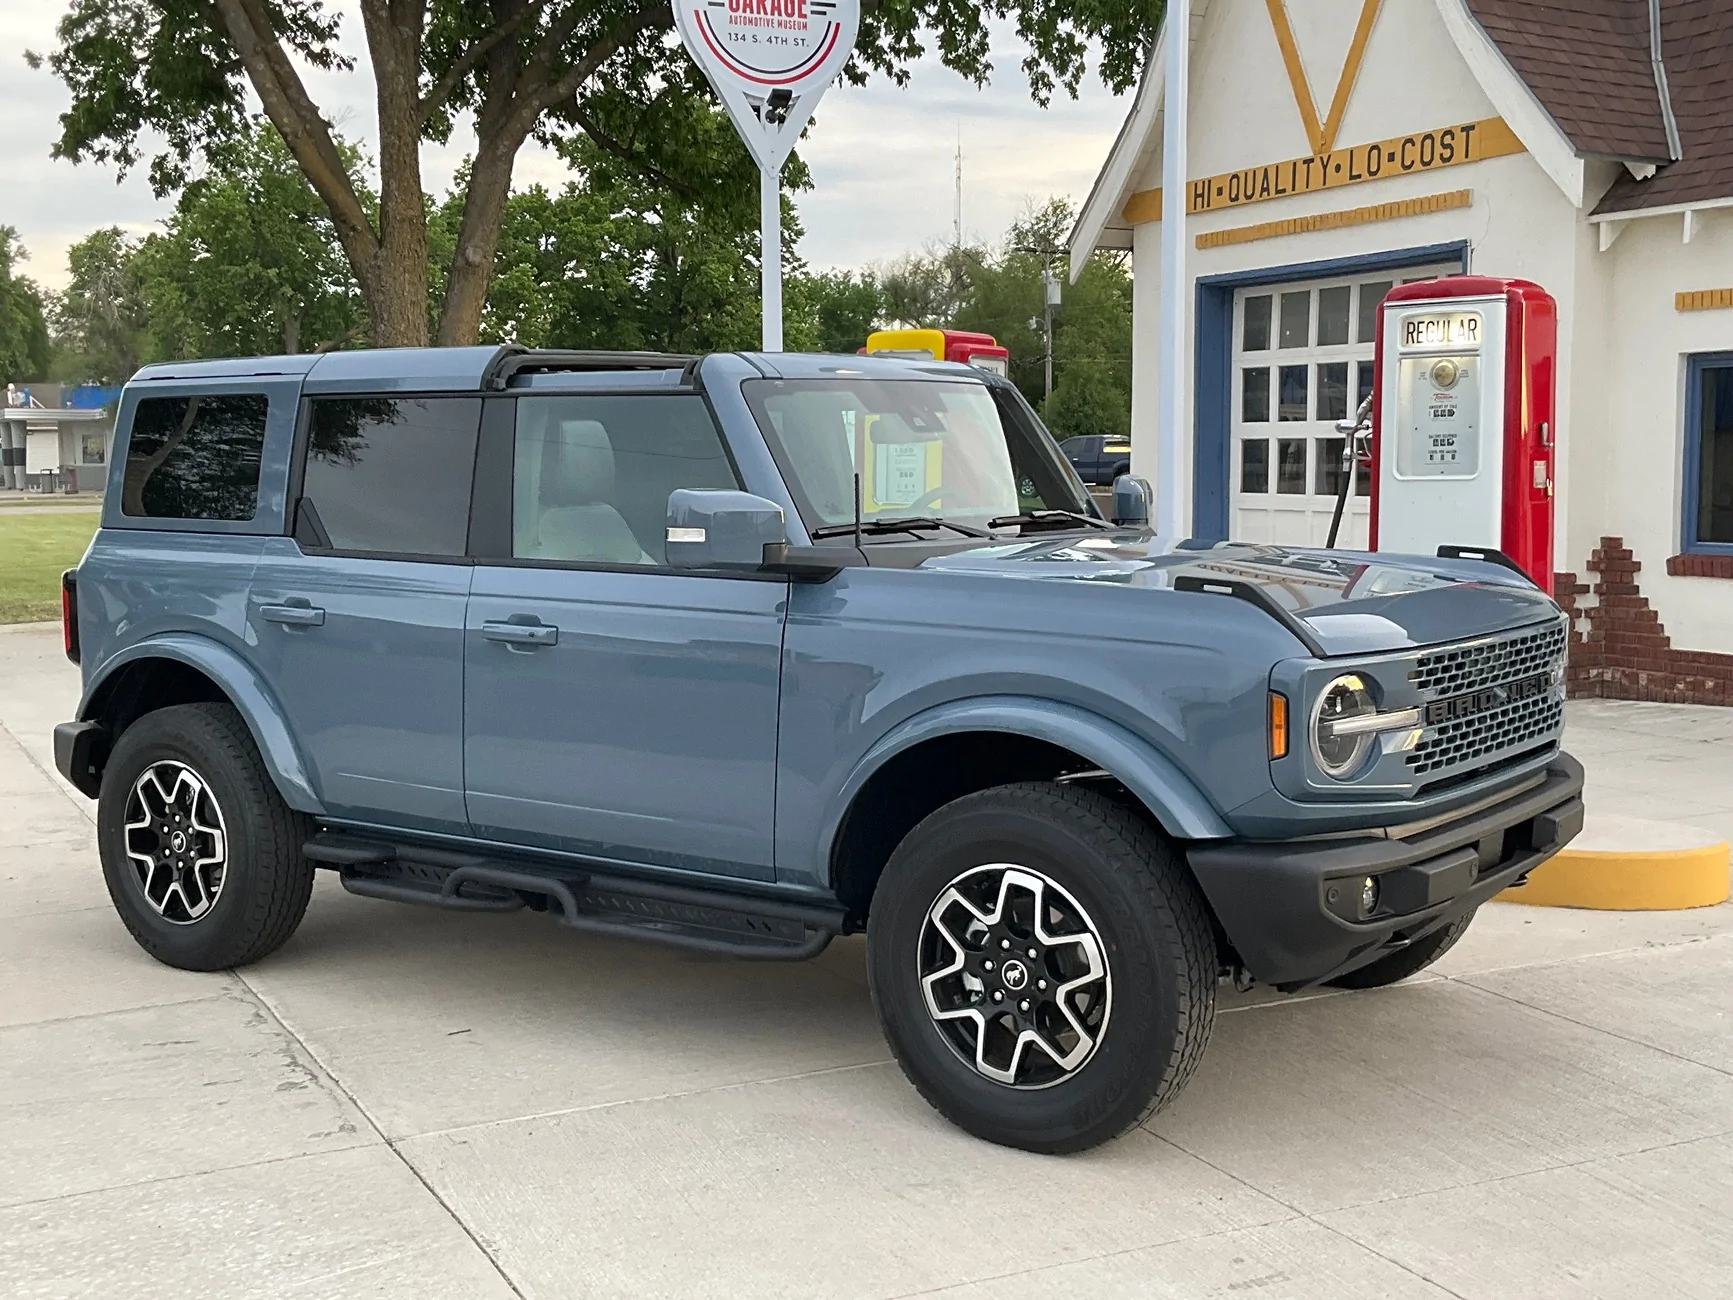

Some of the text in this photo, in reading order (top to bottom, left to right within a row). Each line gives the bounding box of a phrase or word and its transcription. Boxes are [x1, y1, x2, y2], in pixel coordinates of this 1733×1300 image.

[729, 15, 808, 31] AUTOMOTIVE MUSEUM
[728, 32, 809, 47] 134 S. 4TH ST.
[1229, 155, 1332, 202] QUALITY
[1400, 125, 1476, 170] COST
[1406, 318, 1477, 344] REGULAR
